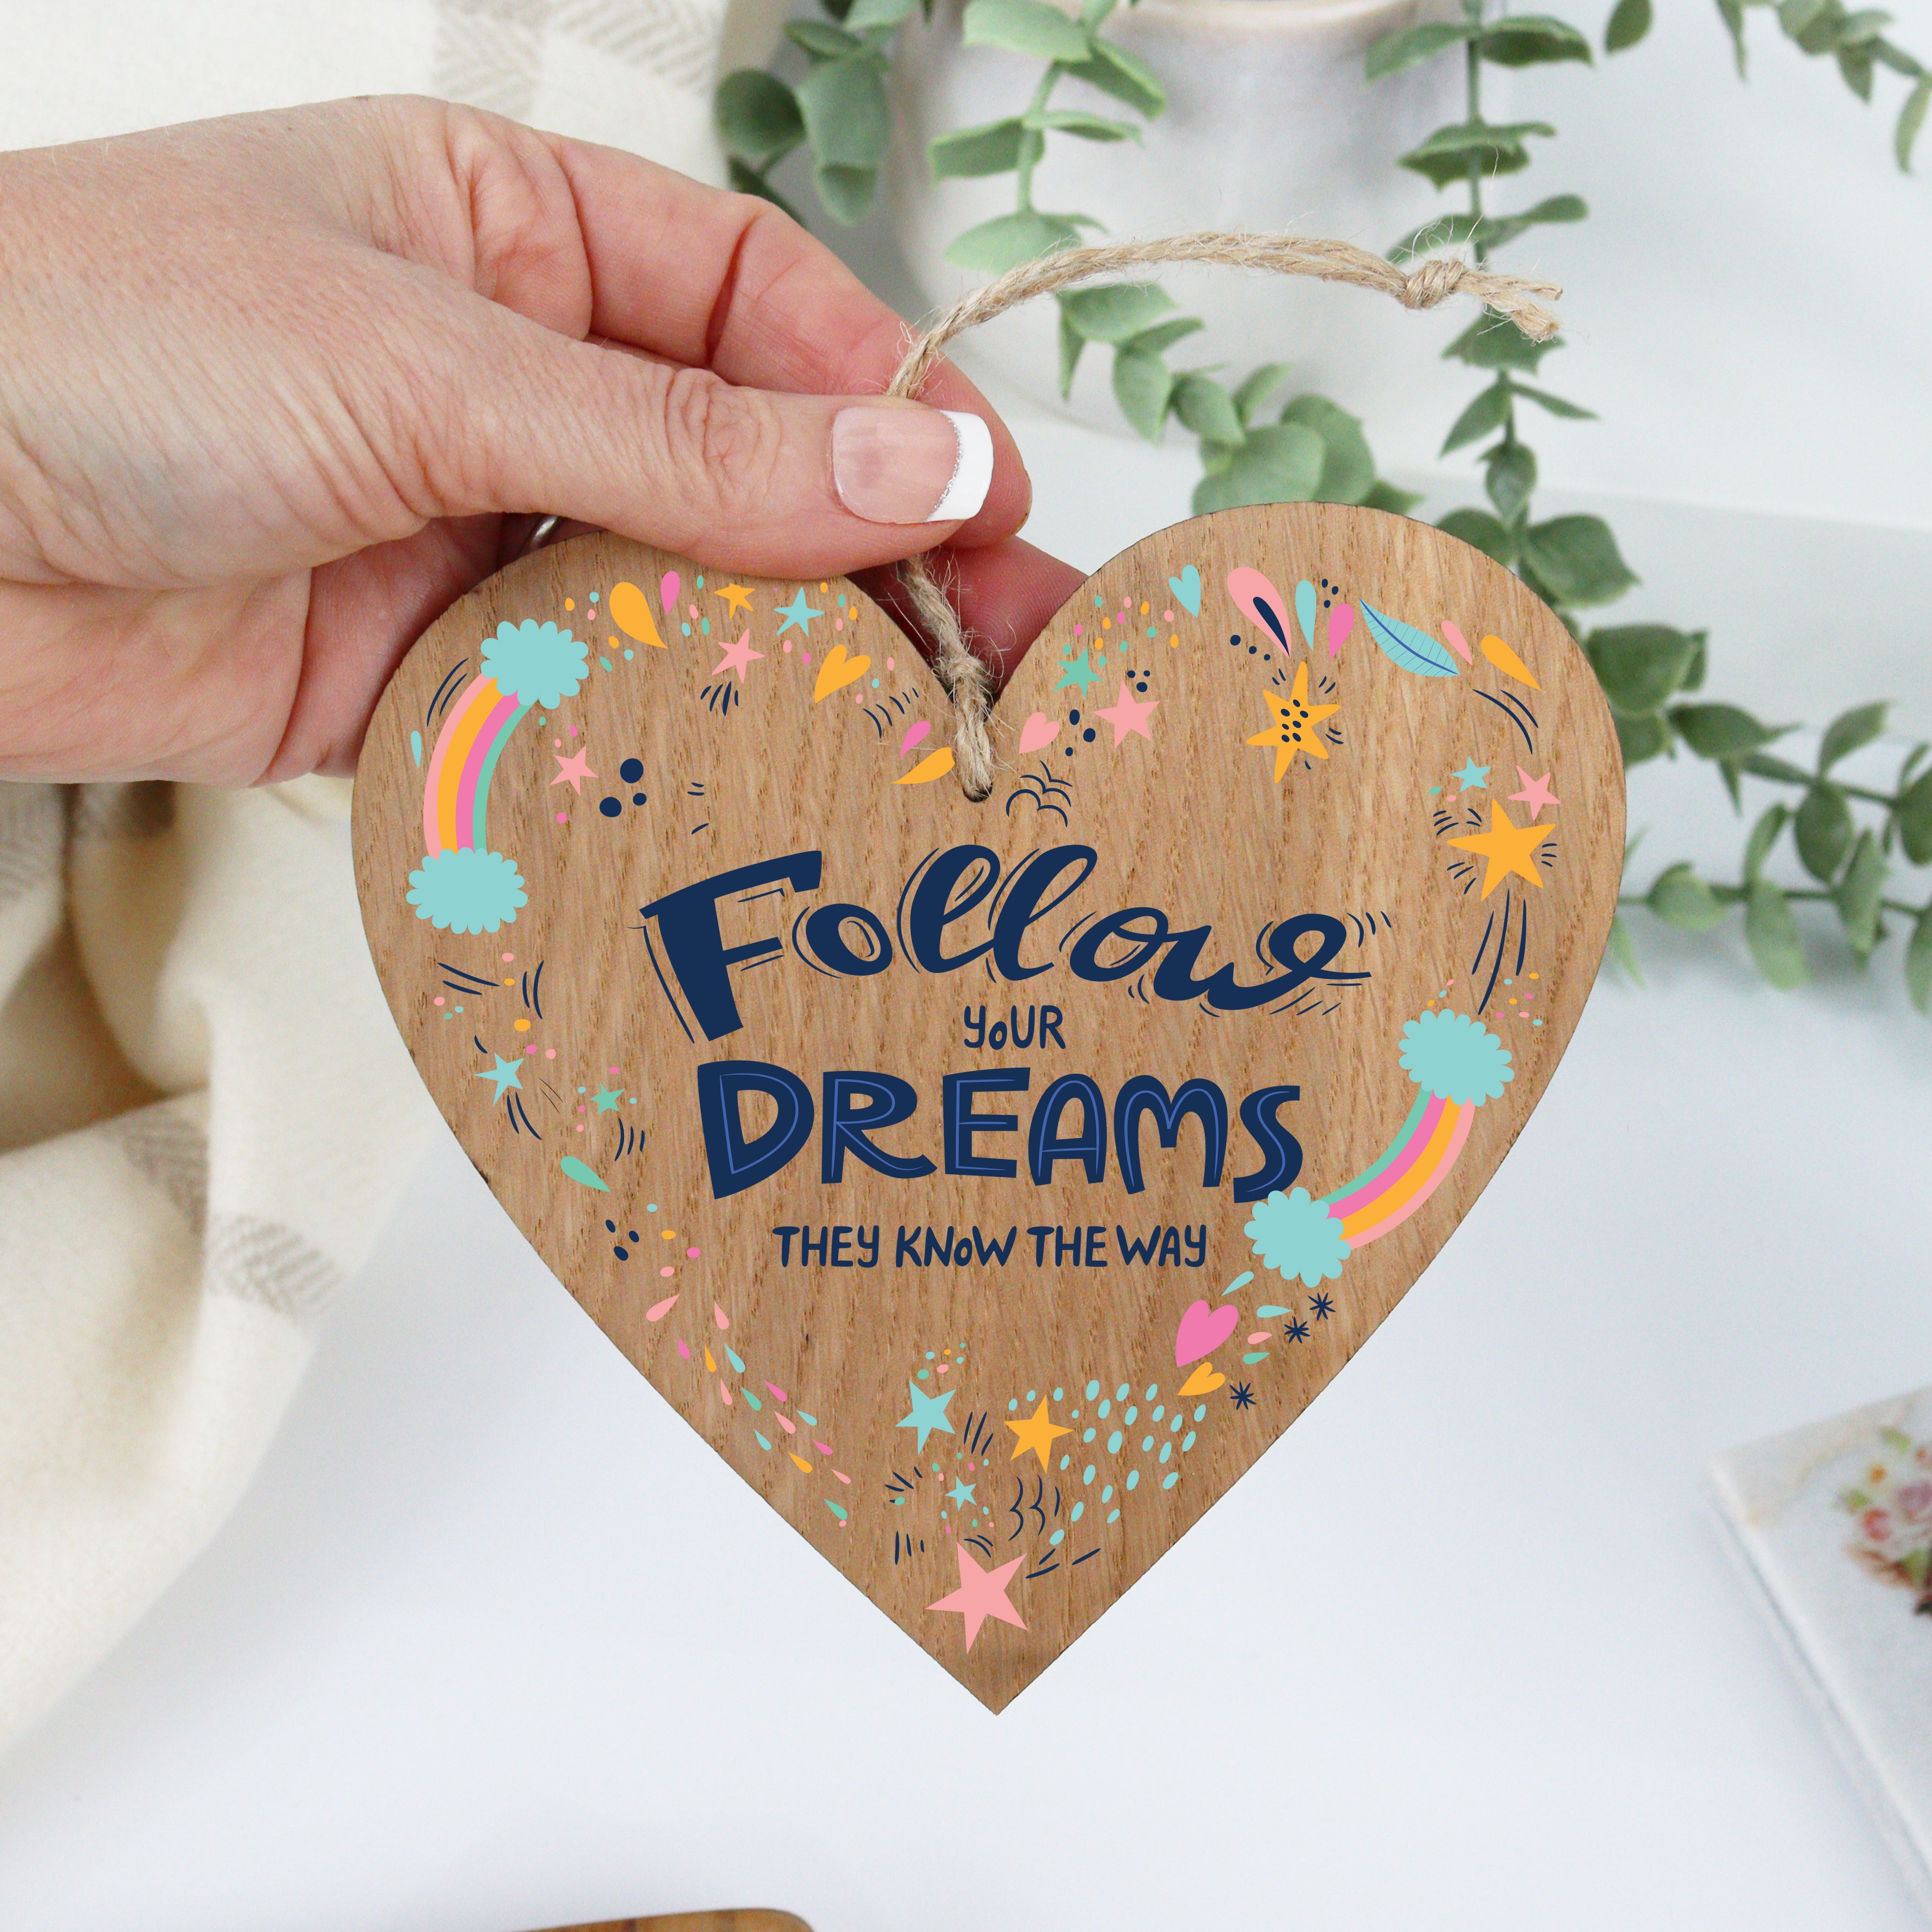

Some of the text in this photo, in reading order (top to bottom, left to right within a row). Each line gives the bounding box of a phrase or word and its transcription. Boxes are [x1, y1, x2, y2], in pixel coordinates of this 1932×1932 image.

[639, 844, 1372, 1041] Follow
[697, 1060, 1303, 1203] DREAMS
[772, 1225, 879, 1268] THEY
[1027, 1226, 1107, 1267] THE
[1116, 1225, 1206, 1267] WAY
